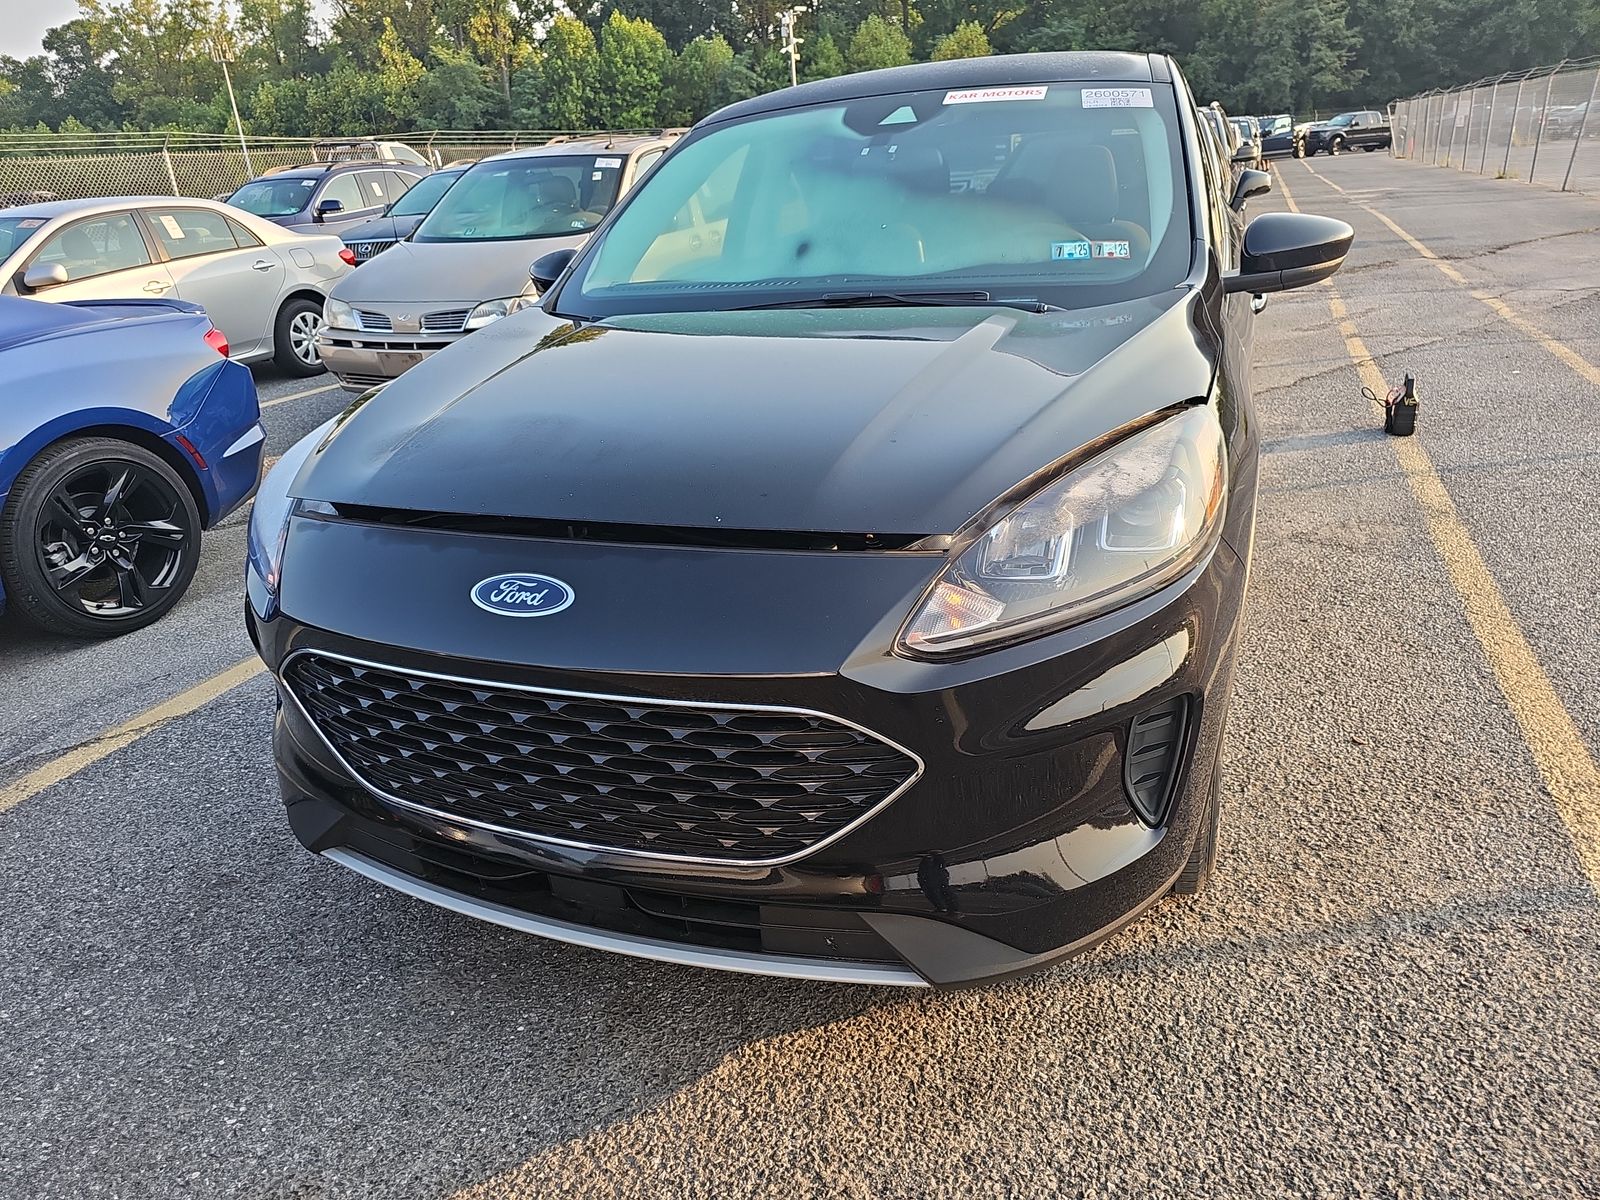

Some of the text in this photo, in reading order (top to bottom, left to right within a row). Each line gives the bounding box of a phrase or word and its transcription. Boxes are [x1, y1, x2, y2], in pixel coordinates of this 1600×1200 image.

[982, 89, 1043, 98] MOTORS
[1085, 90, 1145, 98] 2600571
[1078, 243, 1088, 256] 25
[1118, 243, 1128, 256] 25
[490, 579, 549, 606] Ford
